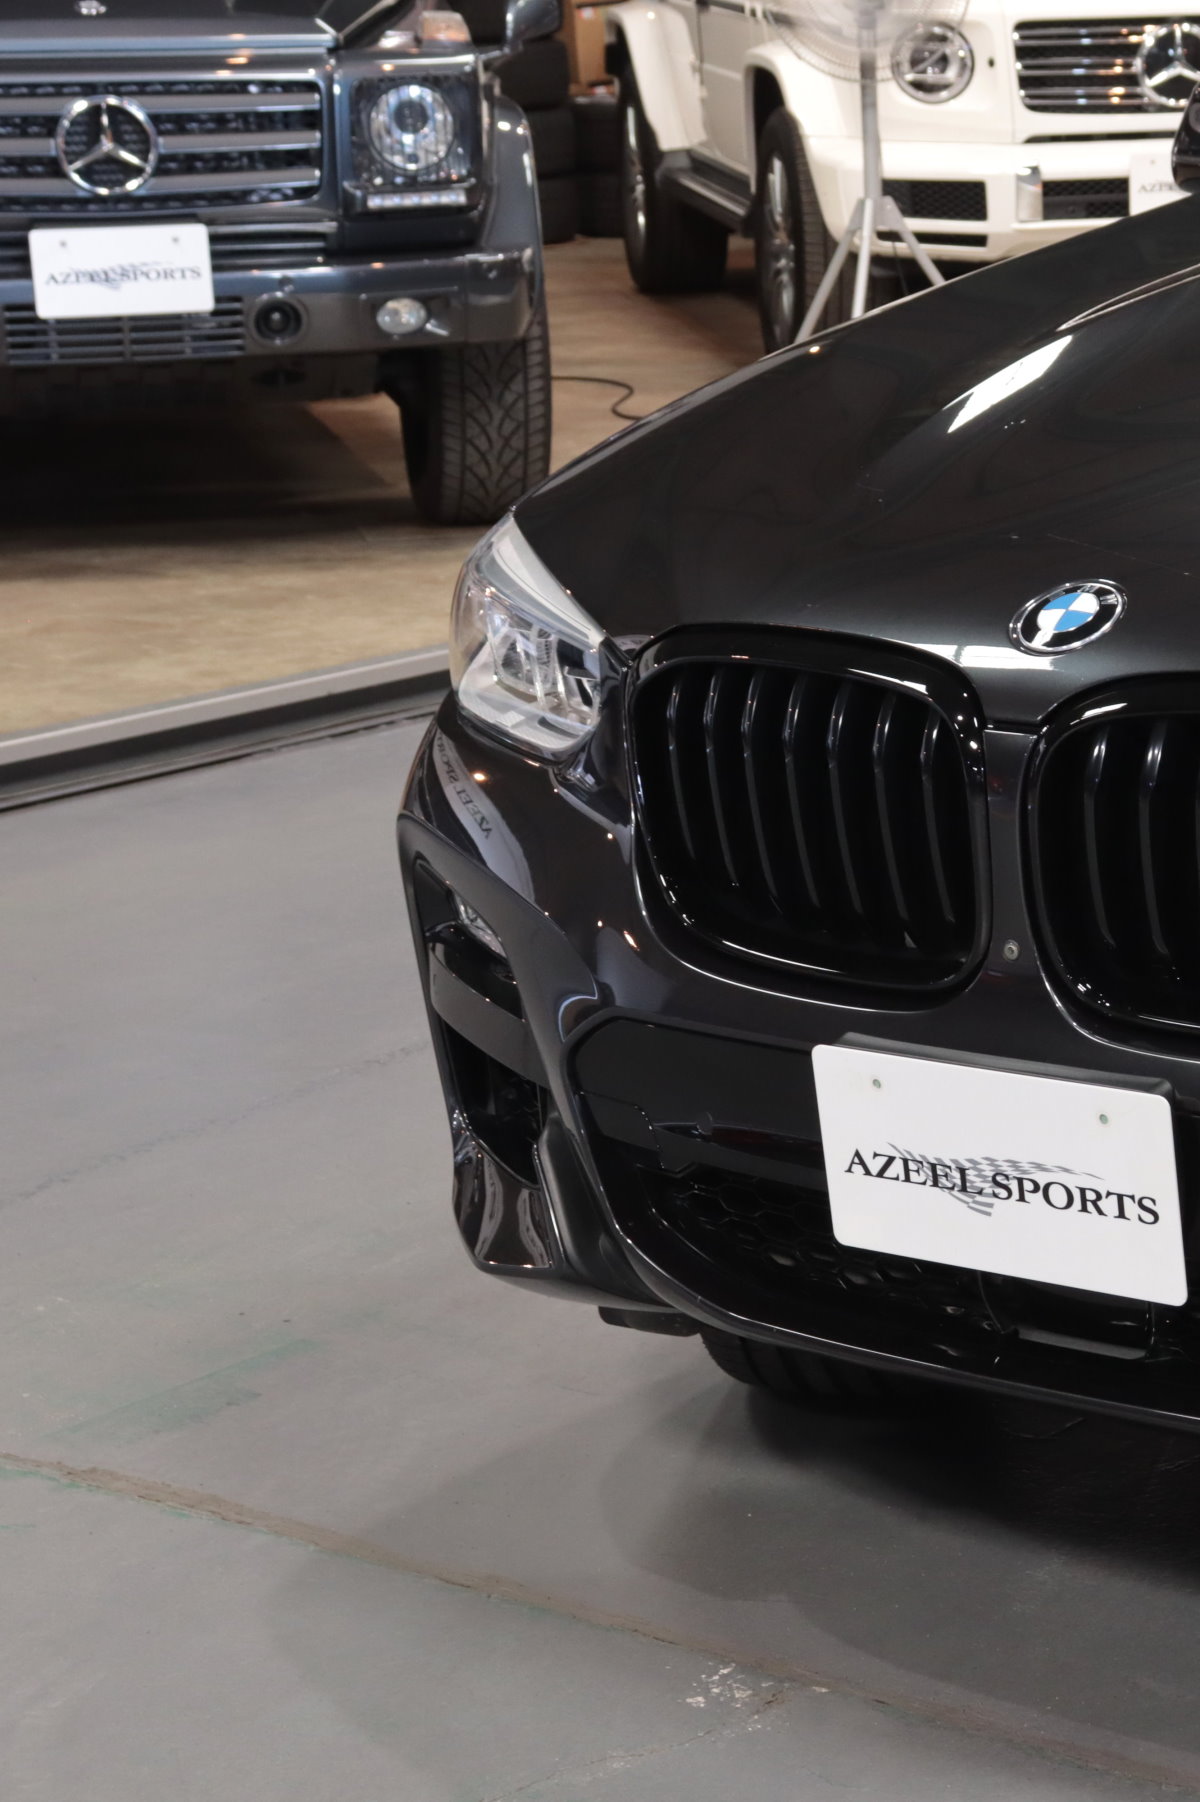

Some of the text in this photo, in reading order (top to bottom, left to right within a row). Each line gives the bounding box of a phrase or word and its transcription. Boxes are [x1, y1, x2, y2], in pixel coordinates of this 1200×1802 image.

[118, 265, 202, 281] SPORTS
[845, 1149, 1160, 1225] AZEEL SPORTS
